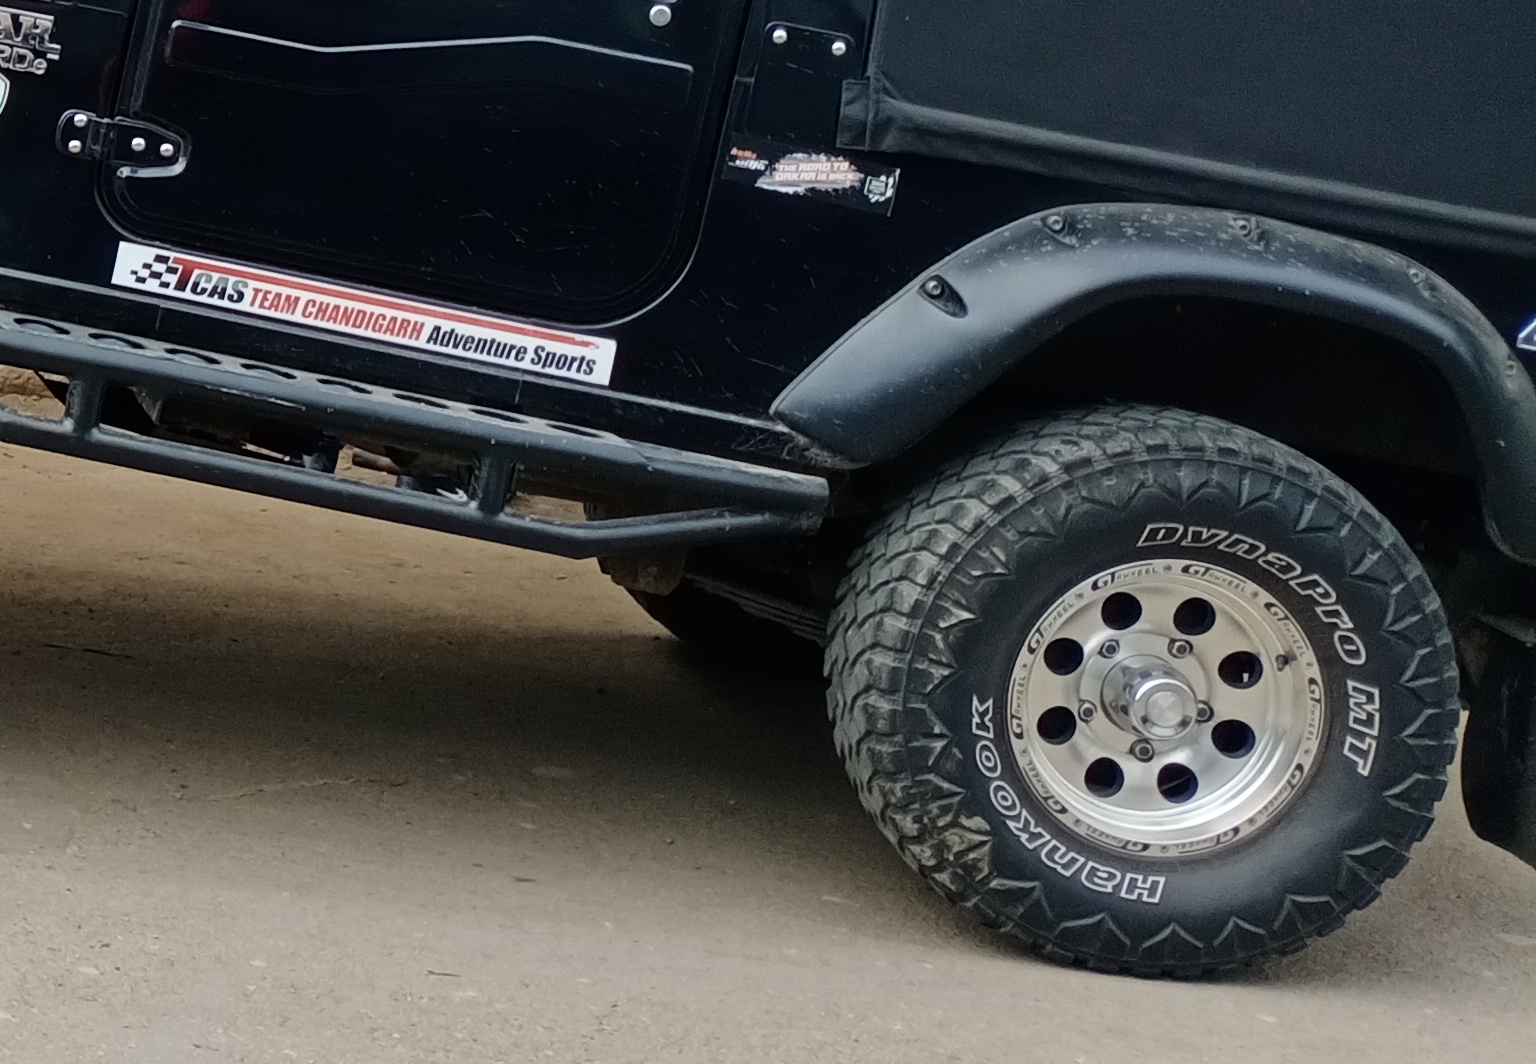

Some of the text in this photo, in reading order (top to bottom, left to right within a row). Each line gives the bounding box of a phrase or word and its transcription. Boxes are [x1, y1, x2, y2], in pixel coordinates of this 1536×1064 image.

[779, 162, 849, 171] THE ROAD TO
[249, 287, 299, 316] TEAM
[301, 298, 425, 342] CHANDIGARH
[426, 324, 527, 364] Adventure
[530, 345, 596, 377] Sports
[1342, 678, 1380, 776] MT
